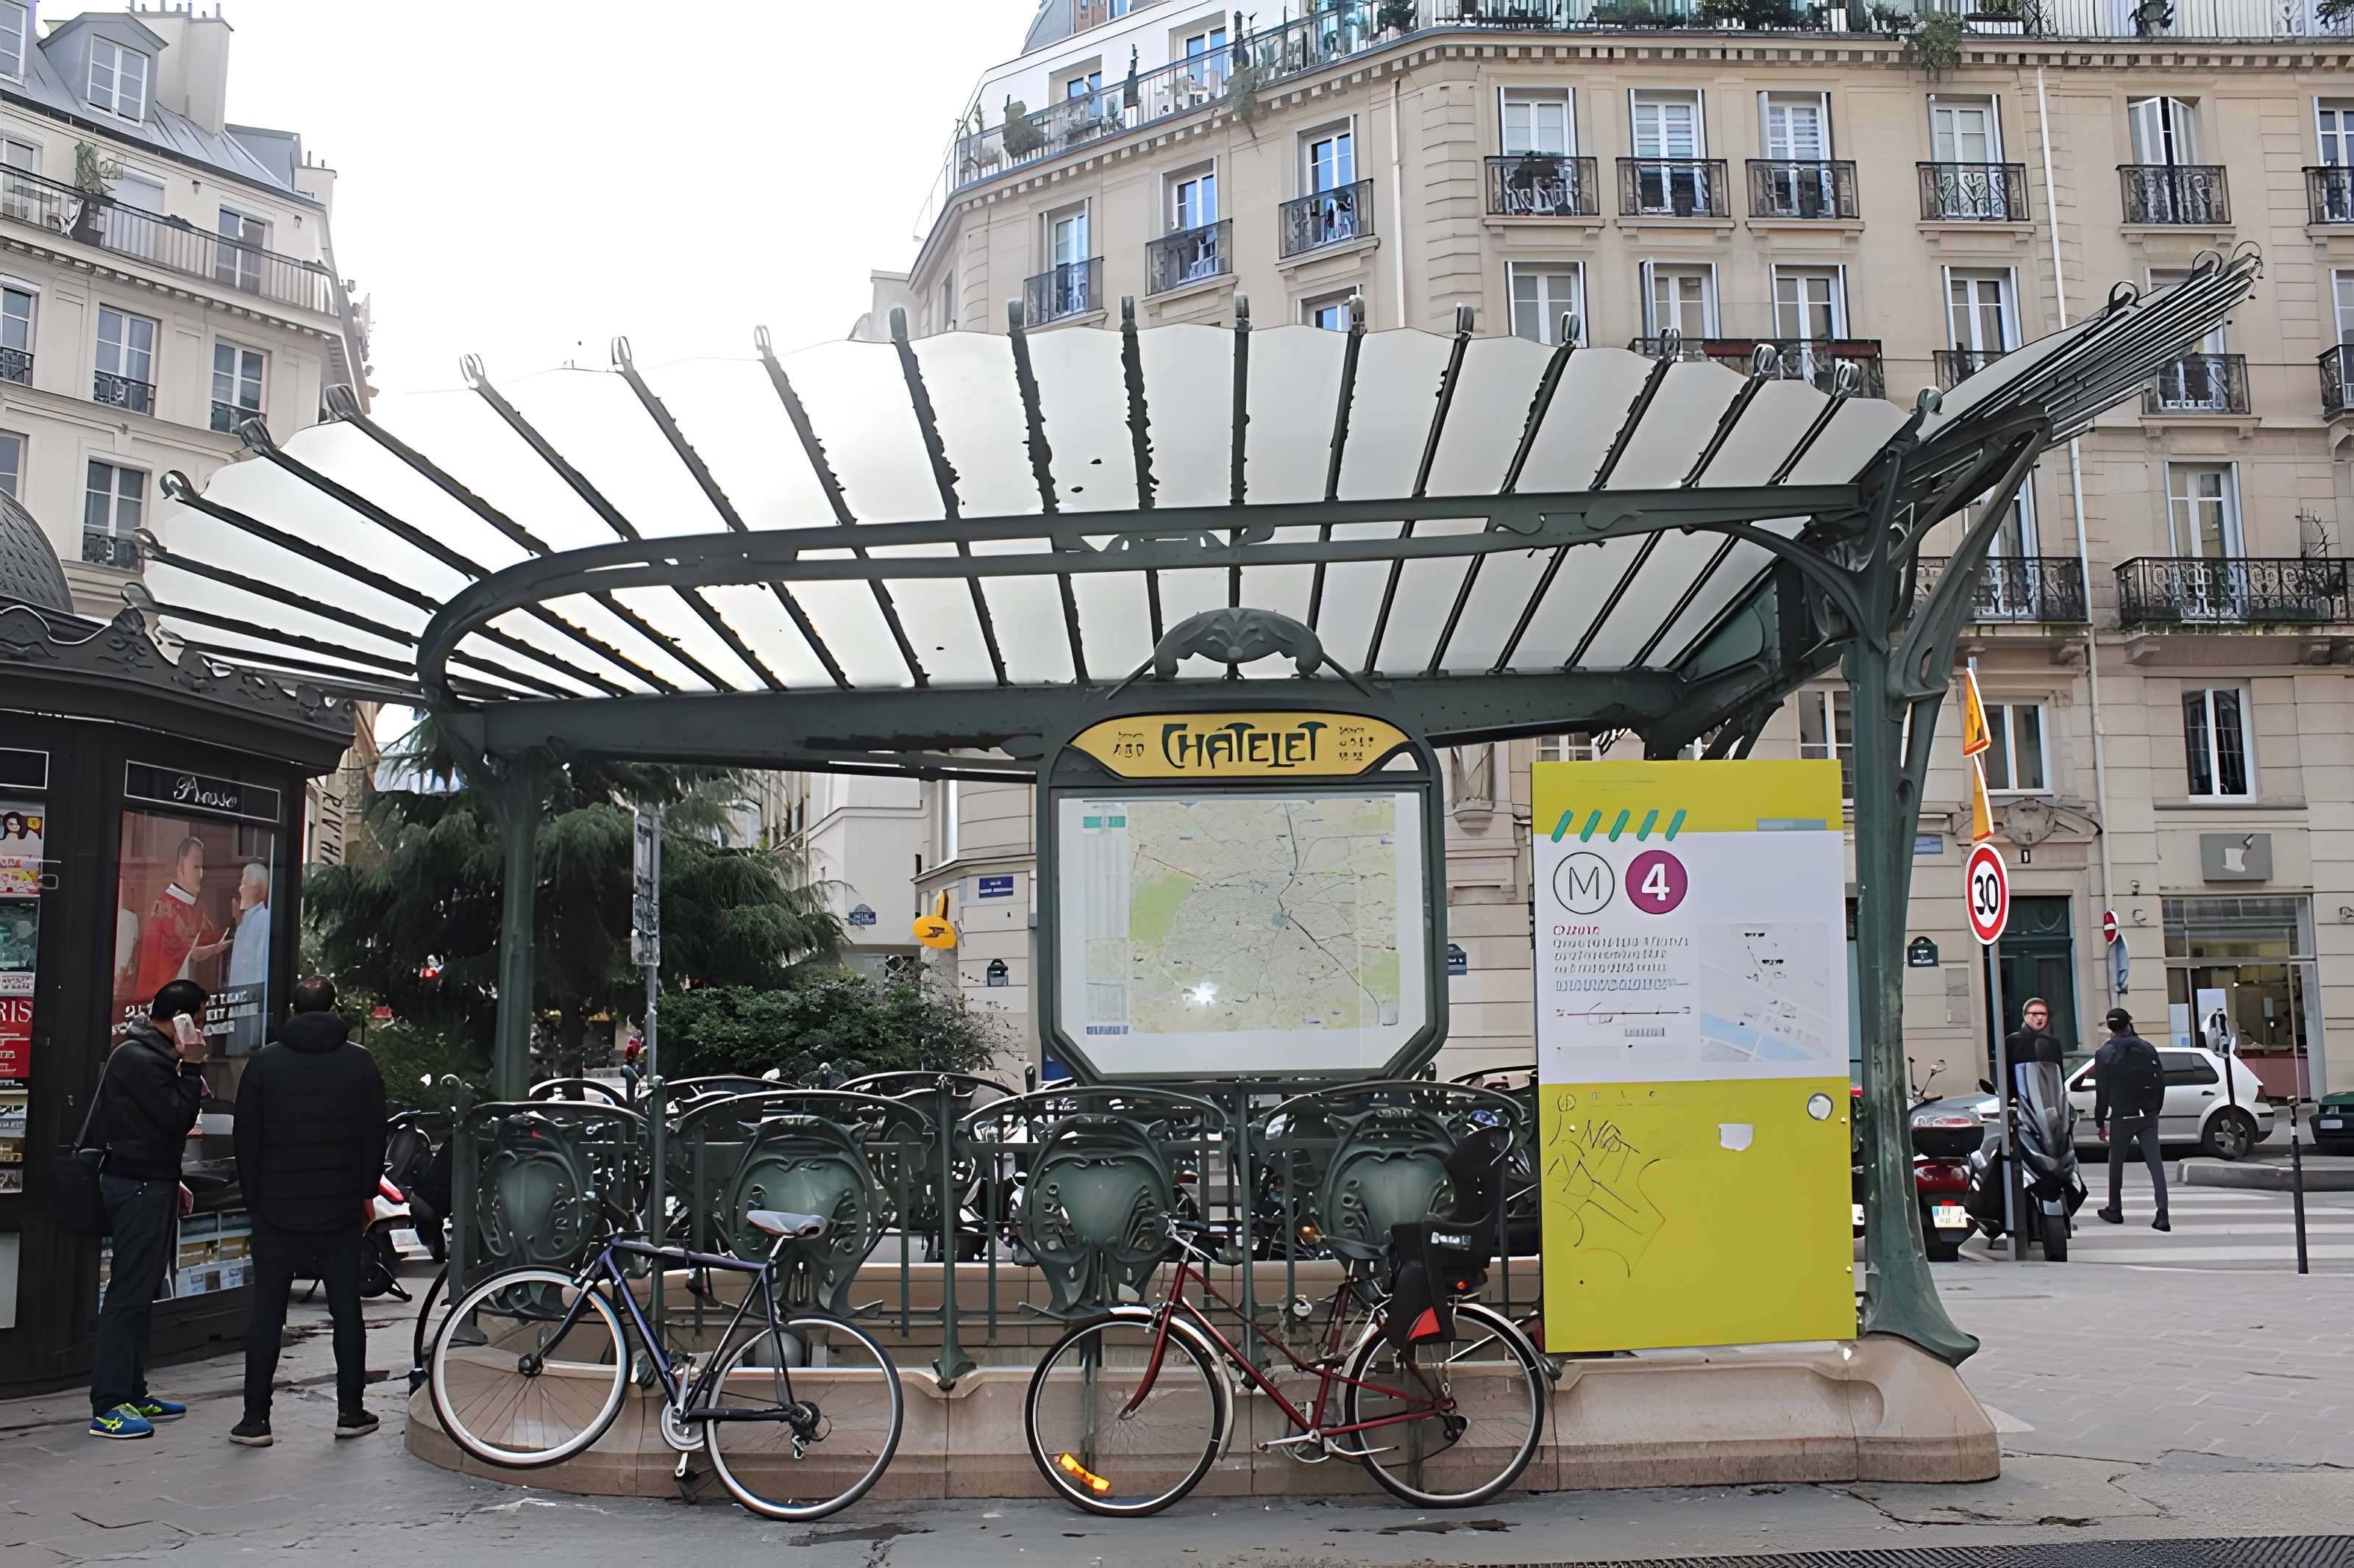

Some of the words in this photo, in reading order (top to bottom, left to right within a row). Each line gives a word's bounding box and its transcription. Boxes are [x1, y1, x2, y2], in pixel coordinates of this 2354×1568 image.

[1568, 866, 1599, 901] M
[1641, 863, 1671, 901] 4
[1974, 873, 1999, 916] 30
